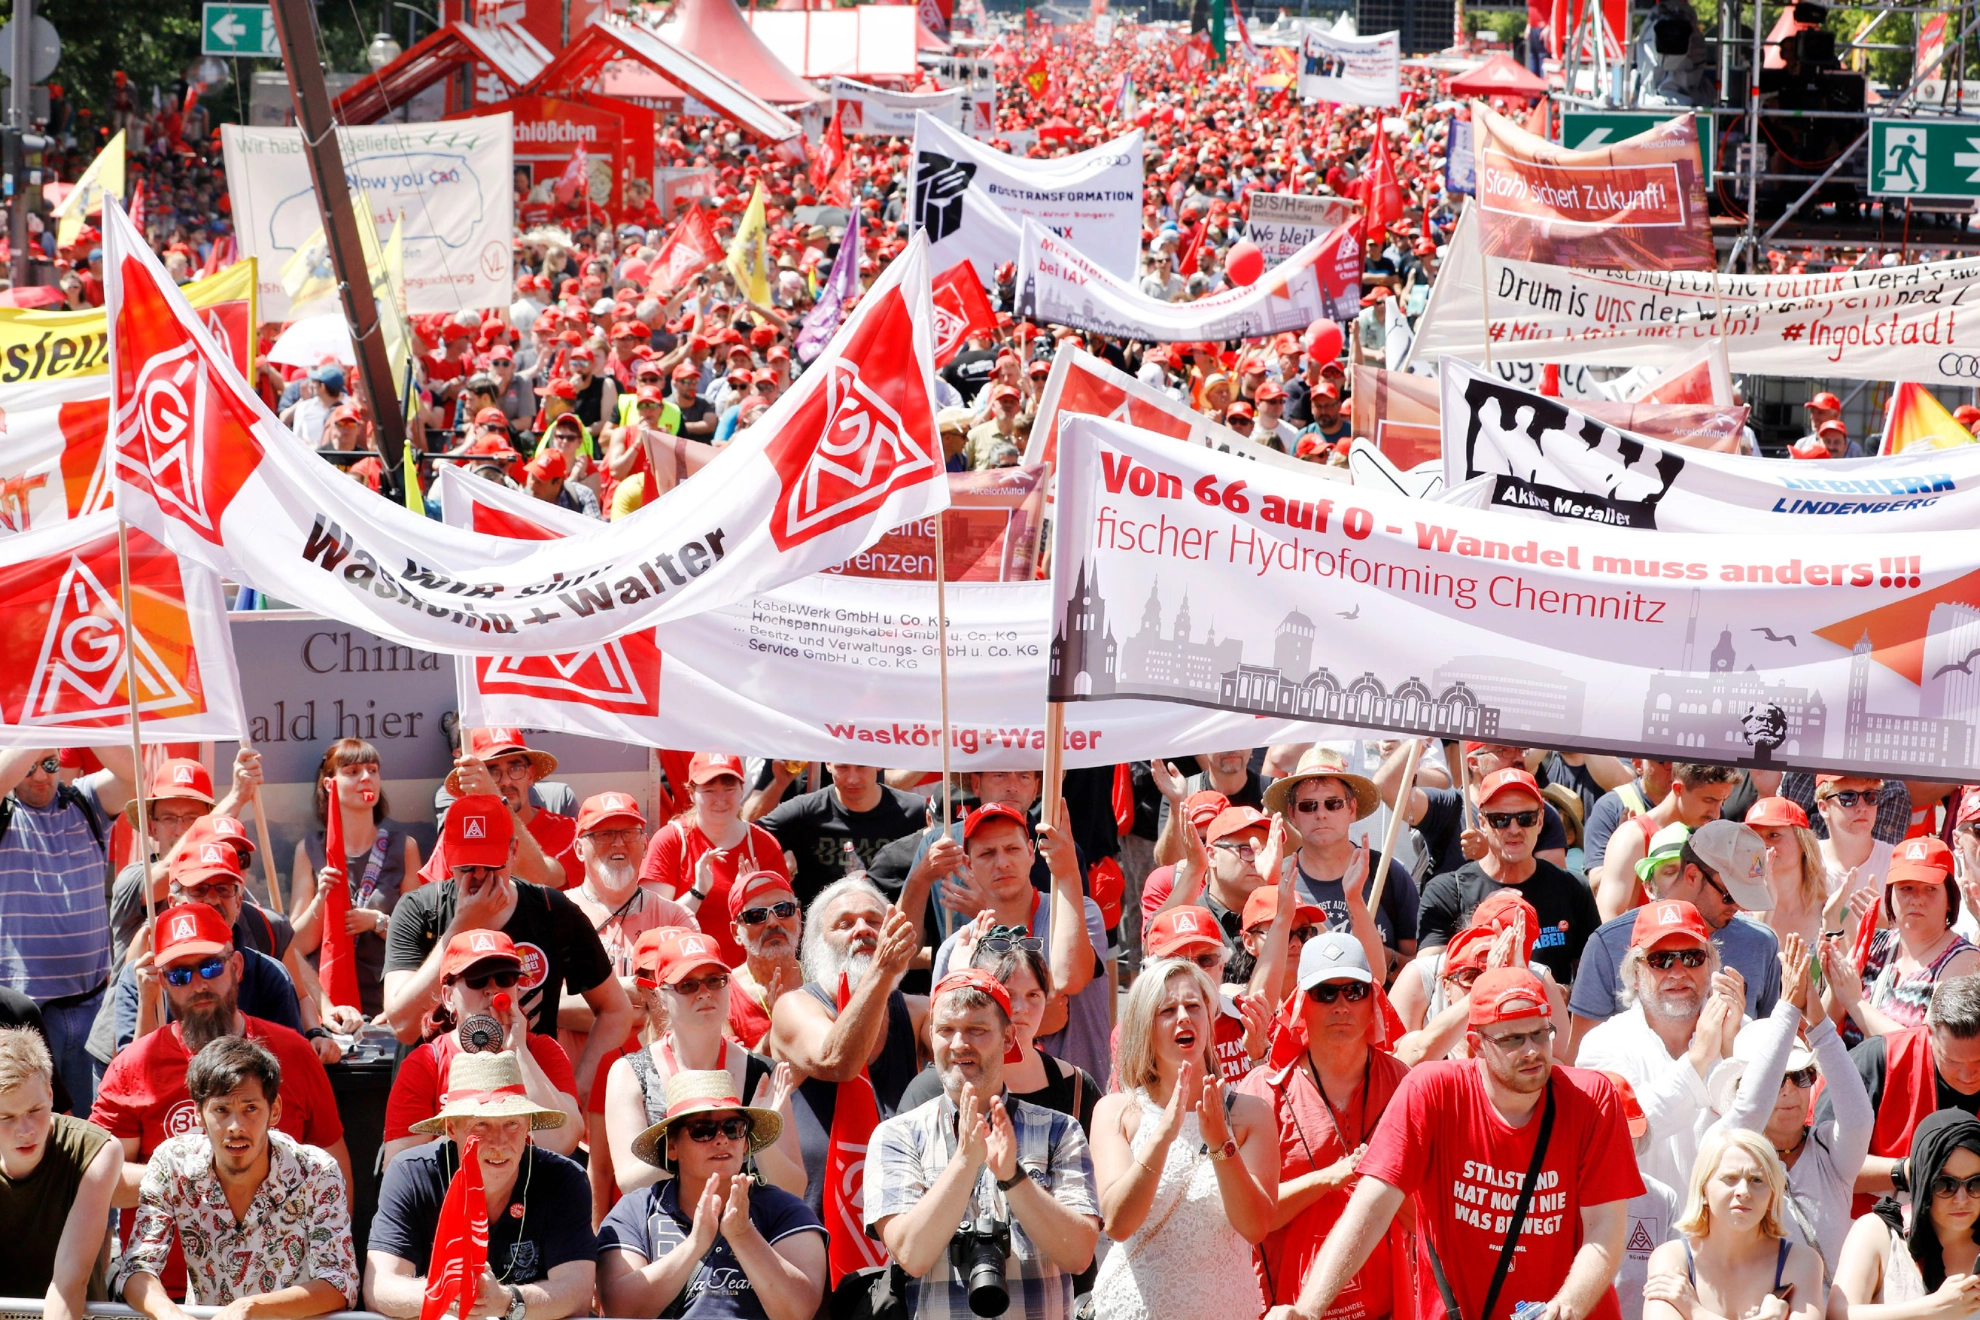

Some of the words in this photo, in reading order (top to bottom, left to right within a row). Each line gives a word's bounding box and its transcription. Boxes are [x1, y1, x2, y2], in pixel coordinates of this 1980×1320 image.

[514, 120, 597, 142] chlößchen
[391, 174, 424, 192] you
[1485, 168, 1527, 199] Stahl
[1530, 180, 1580, 209] sichert
[1582, 182, 1667, 211] Zukunft!
[1250, 224, 1276, 242] Wo
[1280, 226, 1317, 246] bleib
[1039, 258, 1059, 276] bei
[1498, 267, 1562, 315] Drum
[1568, 285, 1589, 318] is
[1594, 294, 1636, 324] uns
[1640, 294, 1687, 324] der
[1782, 311, 1956, 362] #Ingolstadt
[969, 486, 1025, 496] ArcelorMittal
[1772, 496, 1941, 514] LINDENBERG
[1100, 451, 1183, 500] Von
[1194, 474, 1250, 514] 66
[1260, 493, 1335, 535] auf
[1416, 521, 1579, 571] Wandel
[1592, 553, 1716, 580] muss
[1719, 555, 1922, 589] anders!!!
[1554, 496, 1631, 526] Metaller
[557, 527, 726, 618] Walter
[1097, 506, 1218, 561] fischer
[1229, 524, 1477, 610] Hydroforming
[1488, 576, 1667, 624] Chemnitz
[752, 611, 898, 638] Hochspannungskabel
[967, 631, 990, 642] Co.
[996, 631, 1018, 642] KG
[753, 599, 831, 620] Kabel-Werk
[835, 609, 879, 624] GmbH
[884, 614, 896, 625] u.
[900, 614, 924, 626] Co.
[301, 631, 440, 674] China
[749, 625, 794, 641] Besitz-
[799, 635, 825, 648] und
[828, 638, 917, 657] Verwaltungs-
[987, 646, 1012, 657] Co.
[1016, 644, 1039, 656] KG
[749, 639, 799, 658] Service
[804, 650, 847, 663] GmbH
[868, 656, 891, 668] Co.
[896, 657, 918, 669] KG
[250, 700, 318, 743] ald
[333, 699, 423, 739] hier
[824, 722, 1102, 754] Waskönig+Water
[1532, 932, 1565, 950] ABEI!
[1462, 1160, 1559, 1191] STILLSTND
[1453, 1180, 1489, 1206] HAT
[1540, 1191, 1567, 1213] NIE
[1455, 1202, 1492, 1230] WAS
[1323, 1301, 1365, 1318] FAIRWANDEL
